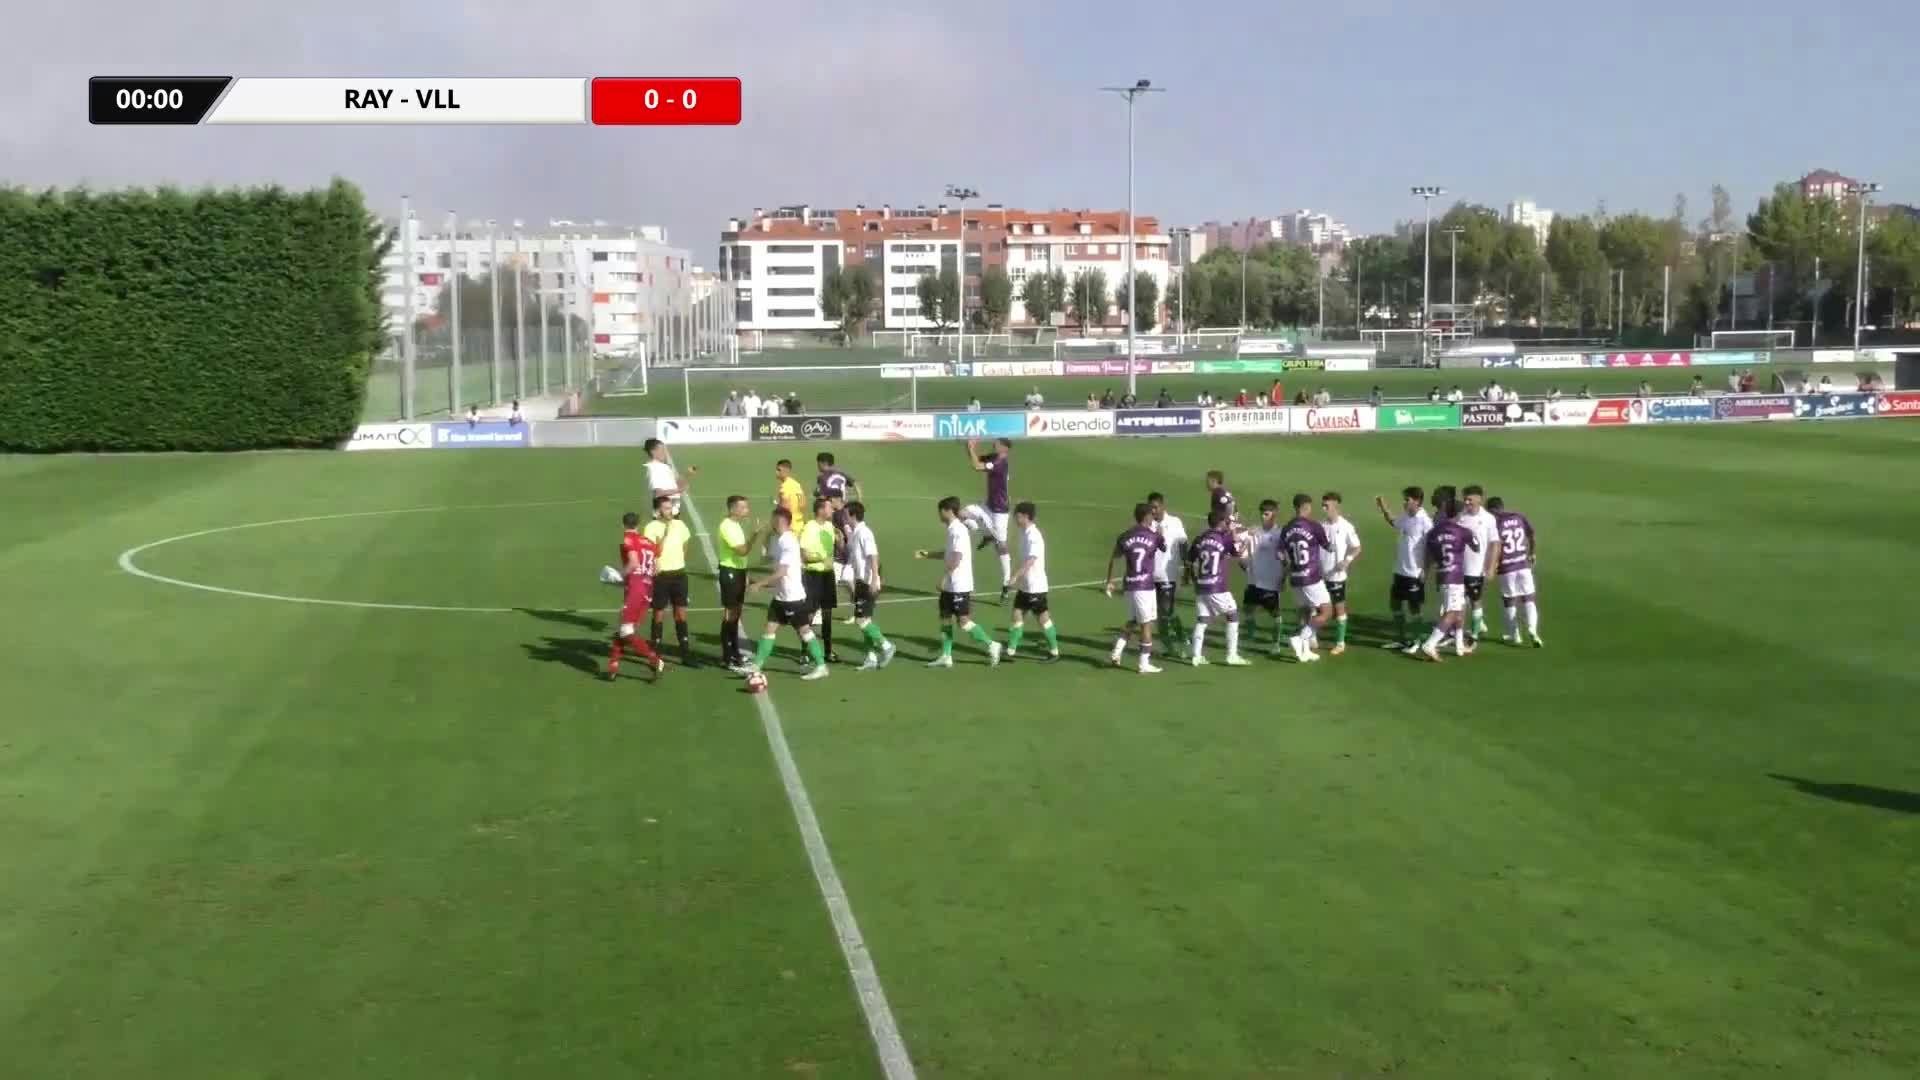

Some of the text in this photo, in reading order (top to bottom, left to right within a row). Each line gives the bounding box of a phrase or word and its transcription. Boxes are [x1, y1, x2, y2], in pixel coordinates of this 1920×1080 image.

[1051, 418, 1112, 431] blendio
[1463, 413, 1504, 423] PASTOR
[1289, 540, 1310, 565] 16
[1502, 527, 1526, 554] 32
[1133, 547, 1146, 573] 7
[1200, 550, 1220, 575] 21
[1441, 543, 1455, 566] 5
